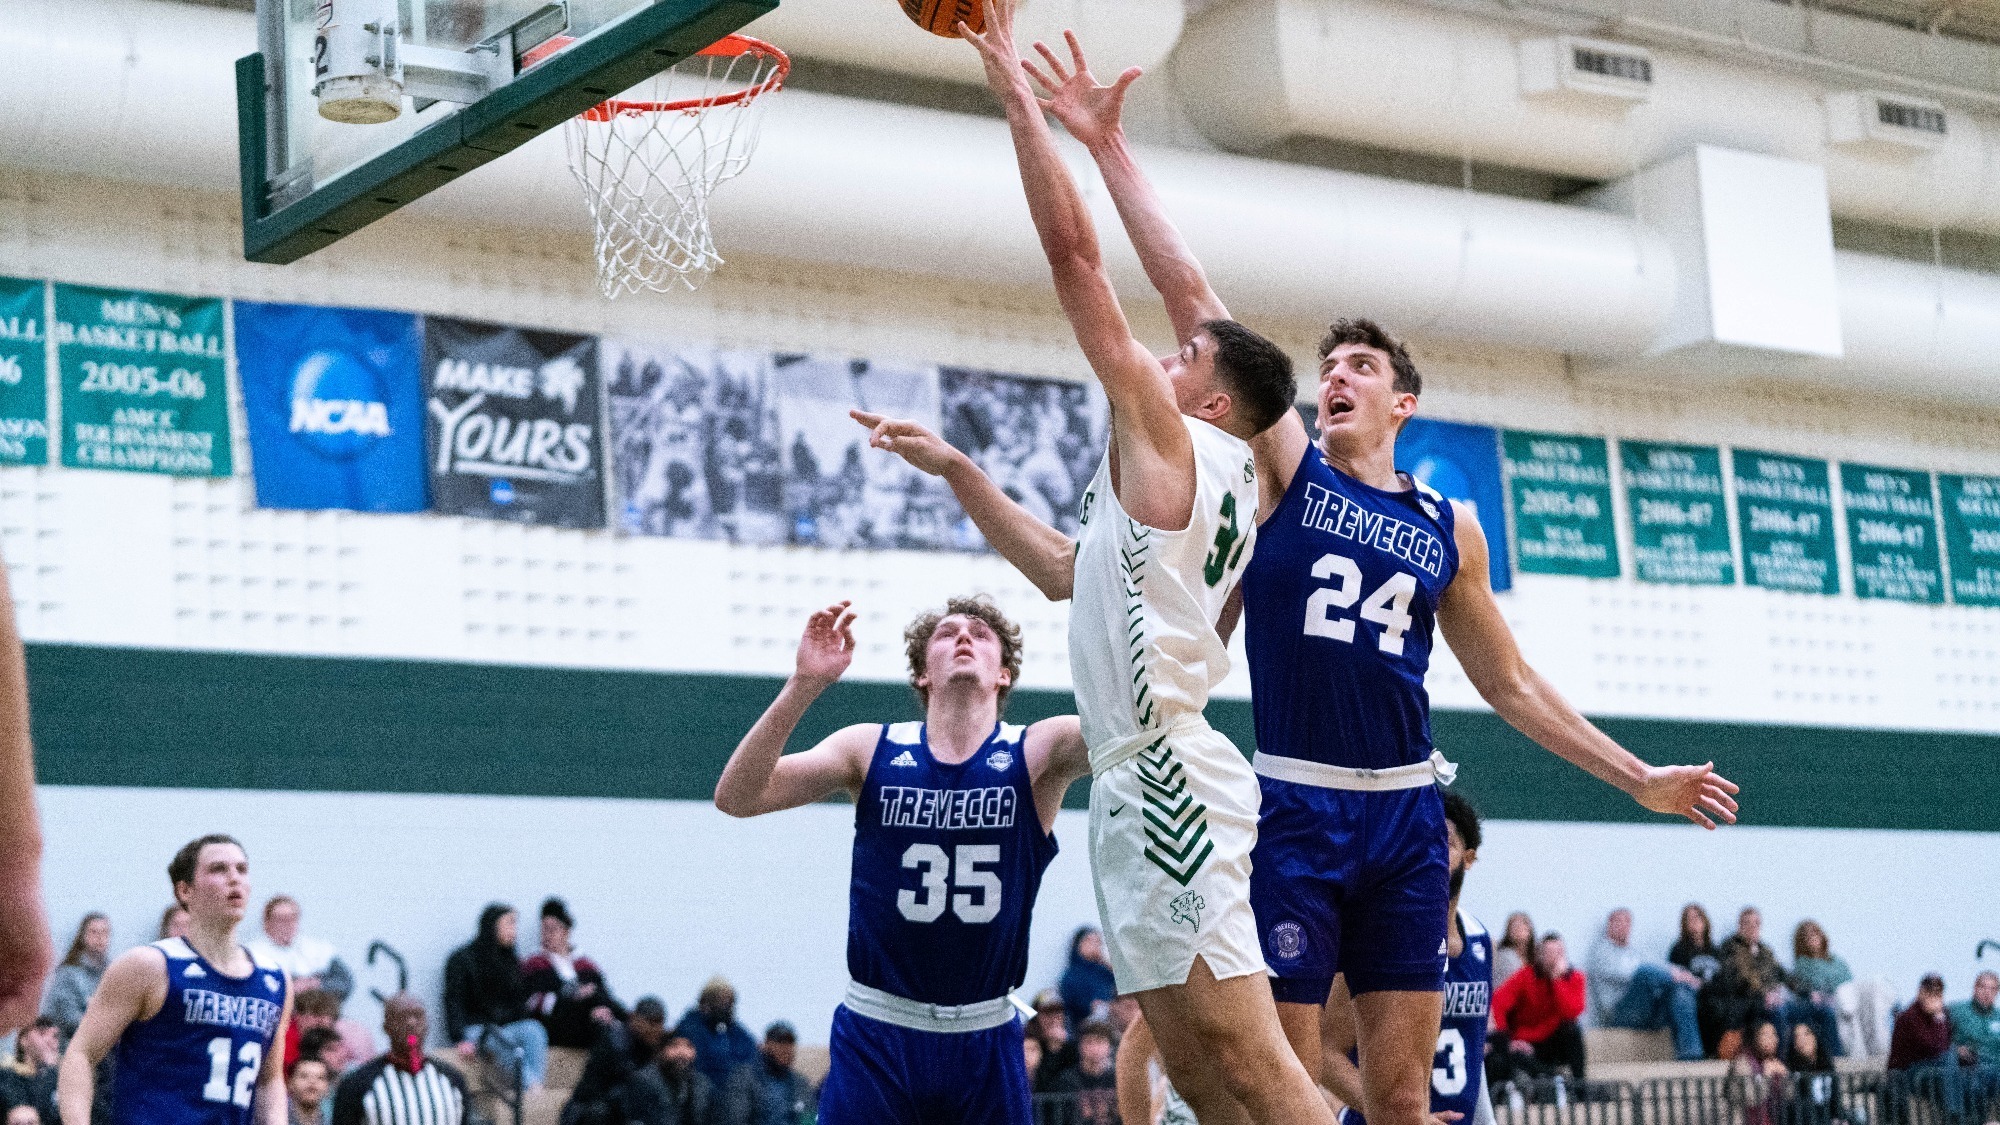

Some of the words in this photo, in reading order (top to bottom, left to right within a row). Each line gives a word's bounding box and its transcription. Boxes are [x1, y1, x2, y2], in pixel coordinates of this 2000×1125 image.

[57, 321, 223, 358] BASKETBALL
[79, 360, 207, 400] 2005-06
[434, 358, 534, 398] MAKE
[290, 398, 391, 437] NCAA
[428, 393, 593, 474] YOURS
[1302, 481, 1443, 577] TREVECCA
[1303, 553, 1417, 656] 24
[880, 786, 1017, 830] TREVECCA
[897, 843, 1002, 924] 35
[1275, 922, 1301, 933] TREVECCA
[203, 1037, 262, 1109] 12
[1432, 1028, 1468, 1096] 3
